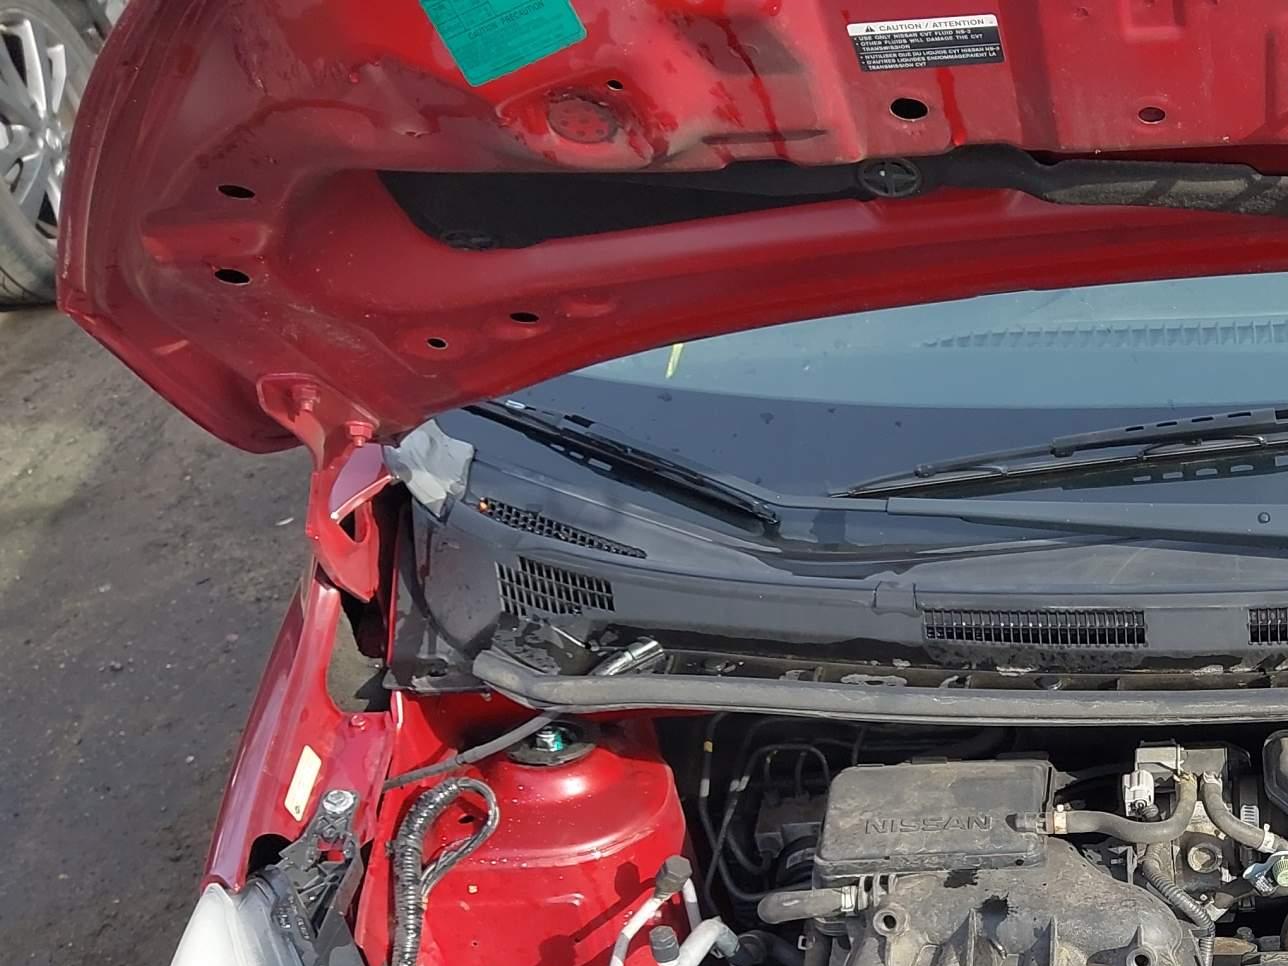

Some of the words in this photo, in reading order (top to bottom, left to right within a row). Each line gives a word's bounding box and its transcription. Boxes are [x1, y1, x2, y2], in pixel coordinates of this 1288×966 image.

[879, 23, 921, 32] CAUTION
[933, 18, 984, 28] ATTENTION
[926, 35, 953, 43] DAMAGE
[862, 44, 911, 52] TRANSMISSION
[868, 62, 914, 70] TRANSMISSION
[865, 815, 993, 835] NISSAN
